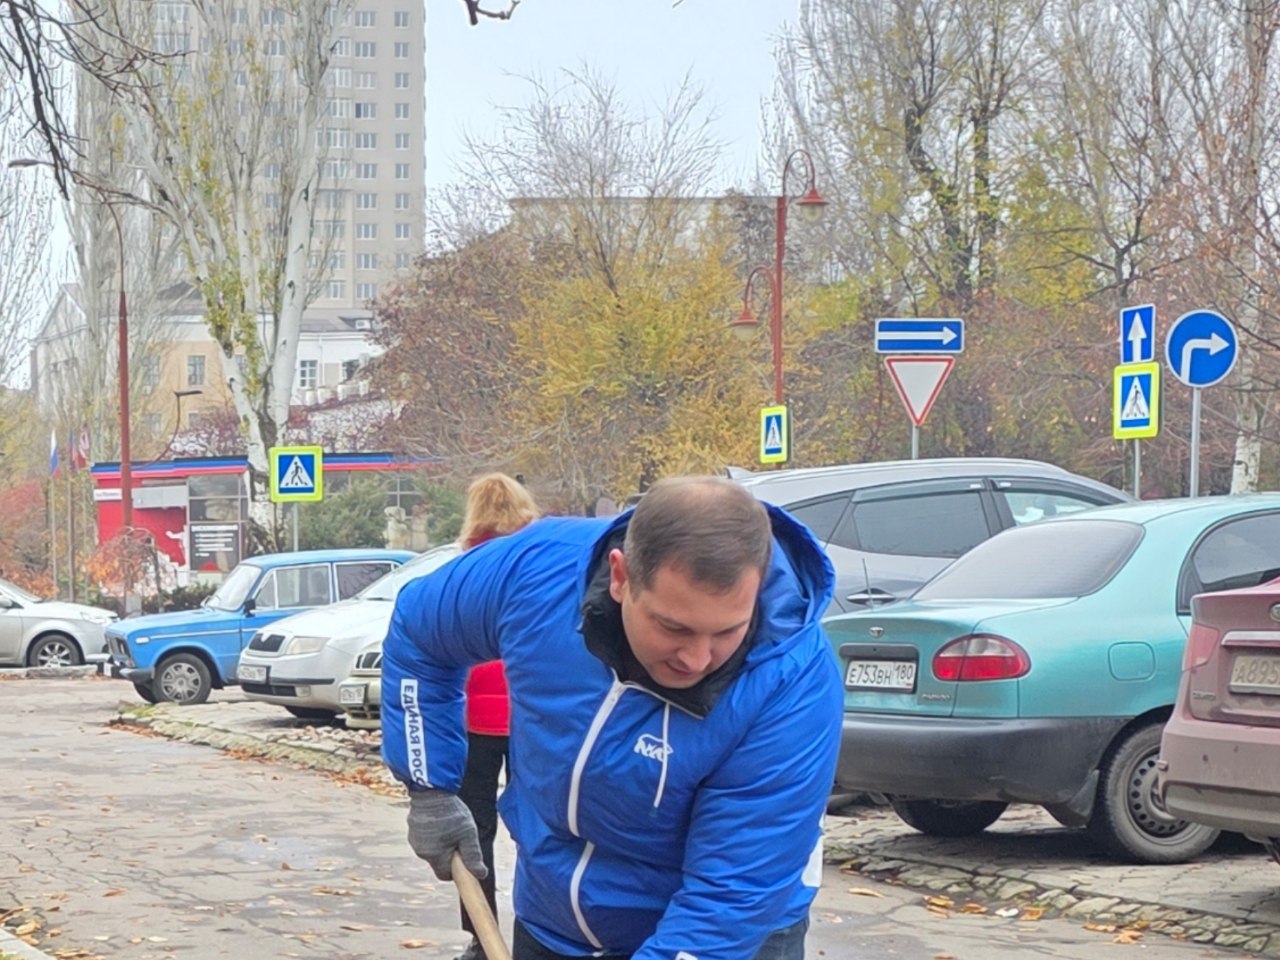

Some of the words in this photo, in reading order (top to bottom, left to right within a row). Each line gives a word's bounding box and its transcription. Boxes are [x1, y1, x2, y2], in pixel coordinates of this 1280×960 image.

[895, 664, 913, 680] 180
[1235, 660, 1280, 685] А895
[403, 685, 421, 744] ЕДИНАЯ
[411, 748, 426, 785] РОСС
